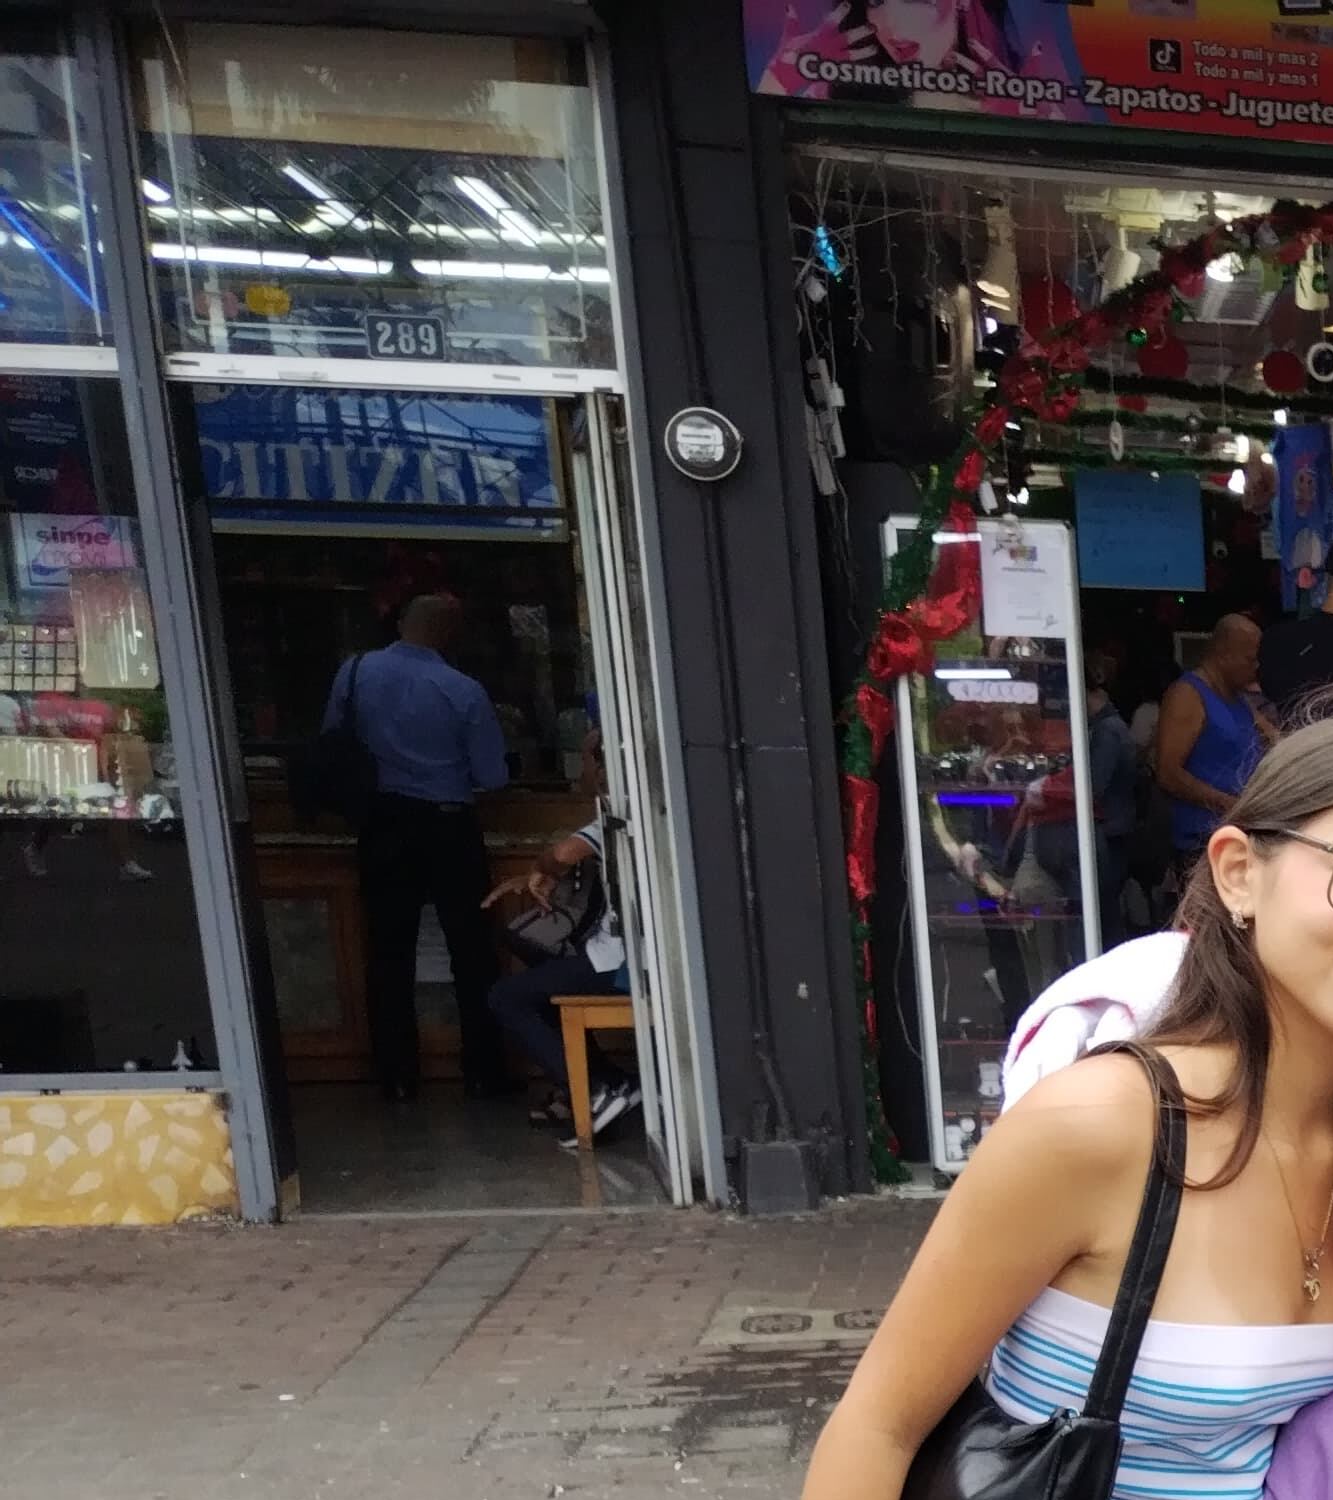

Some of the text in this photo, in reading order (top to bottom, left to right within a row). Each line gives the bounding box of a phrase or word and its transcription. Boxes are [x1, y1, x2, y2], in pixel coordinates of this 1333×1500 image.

[1193, 41, 1223, 58] Todo
[1227, 48, 1239, 58] a
[1241, 47, 1264, 61] mil
[1266, 52, 1276, 67] y
[1310, 53, 1320, 66] 2
[798, 52, 970, 95] Cosmeticos
[1083, 78, 1204, 116] Zapatos
[1193, 61, 1225, 79] Todo
[1227, 68, 1239, 79] a
[1240, 67, 1264, 81] mil
[1266, 72, 1276, 86] y
[1312, 75, 1320, 87] 1
[375, 321, 438, 355] 289
[35, 525, 113, 548] sinpe
